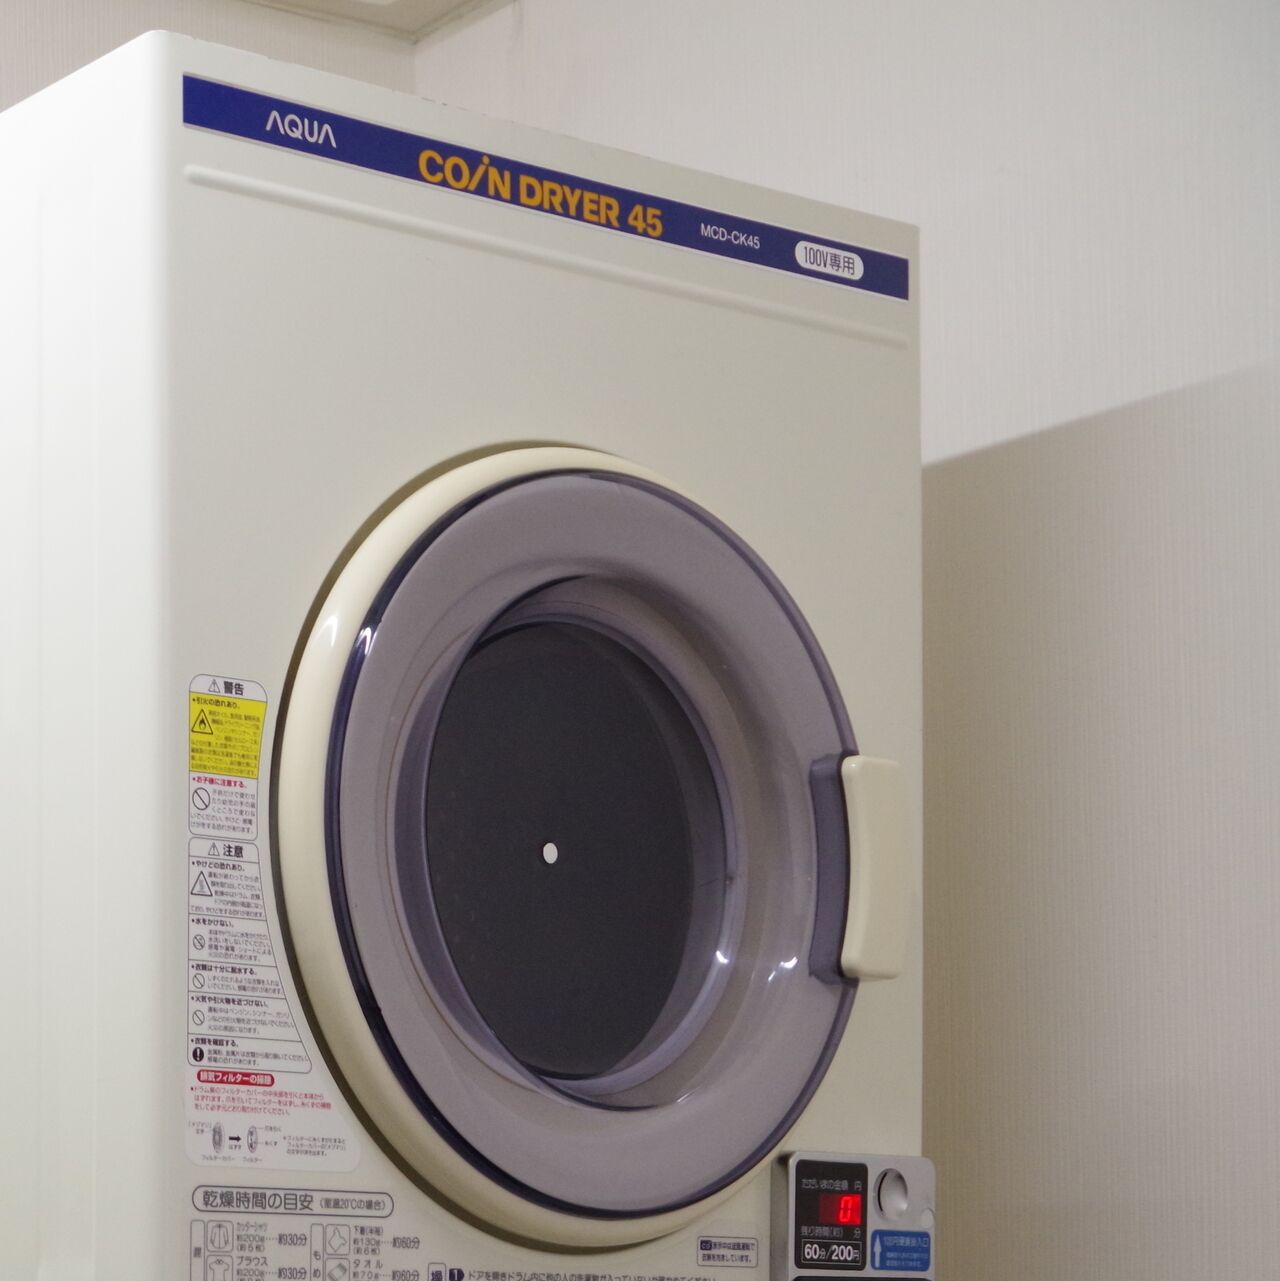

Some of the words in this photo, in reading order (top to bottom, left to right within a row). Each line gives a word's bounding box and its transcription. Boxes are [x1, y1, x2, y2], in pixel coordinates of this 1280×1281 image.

[265, 110, 337, 148] AQUA
[520, 175, 620, 228] DRYER
[627, 205, 663, 238] 45
[700, 222, 760, 249] MCD-CK45
[803, 245, 855, 276] 100V専用
[223, 681, 244, 696] 警告
[223, 844, 244, 858] 注意
[202, 1190, 314, 1211] 乾燥時間の目安
[839, 1196, 852, 1222] 0
[278, 1233, 307, 1246] 約30分
[277, 1267, 307, 1280] 約30分
